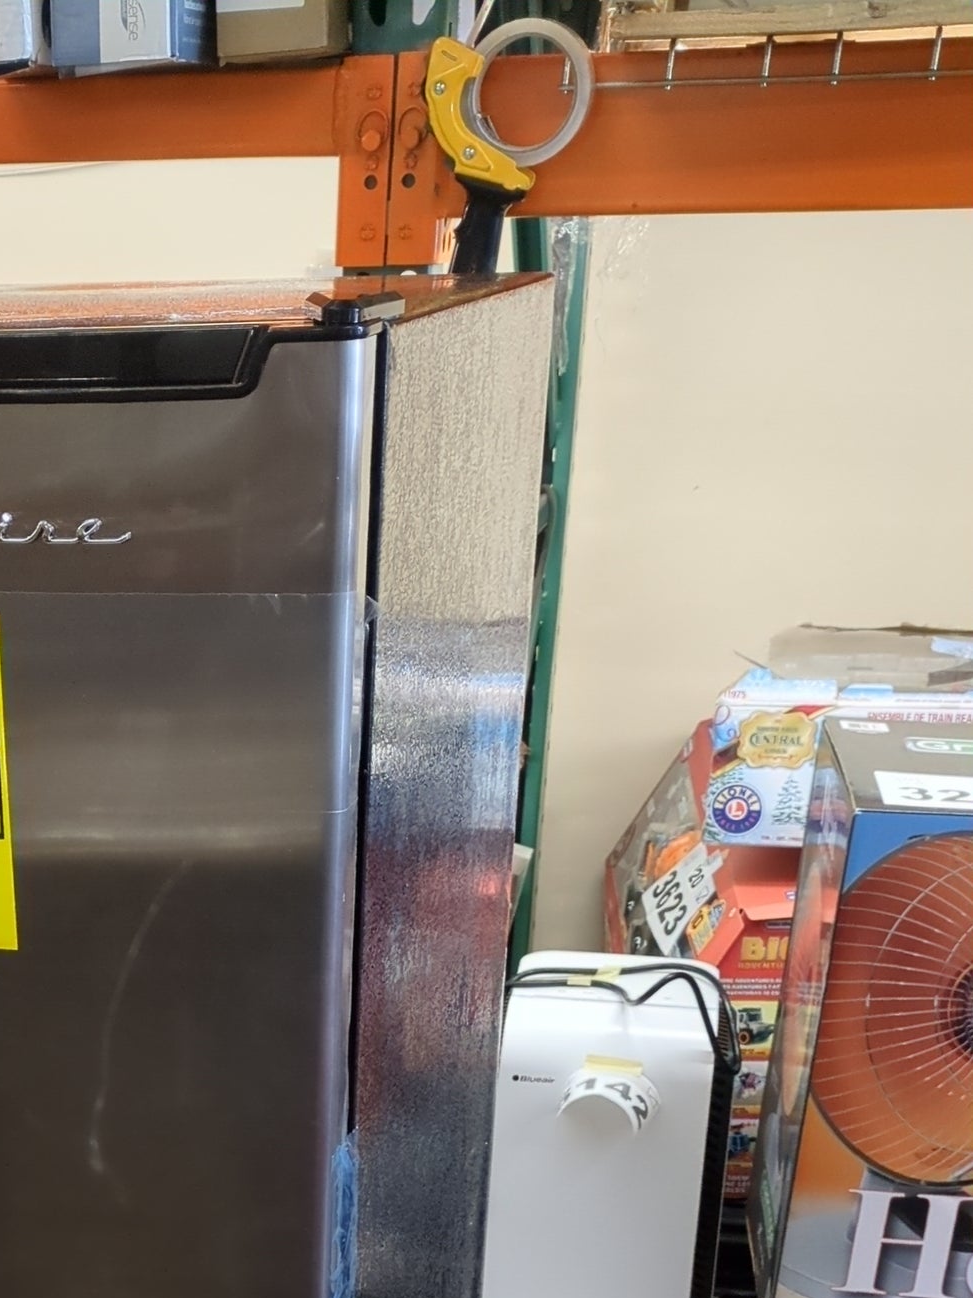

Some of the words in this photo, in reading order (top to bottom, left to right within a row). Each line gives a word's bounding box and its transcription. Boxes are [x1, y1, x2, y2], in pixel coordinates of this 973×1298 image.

[868, 711, 913, 721] ENSEMBLE
[913, 712, 925, 721] DE
[928, 713, 953, 723] TRAIN
[749, 732, 804, 747] CENTRAL
[715, 786, 759, 806] LIONEL
[653, 869, 688, 936] 3623
[519, 1075, 555, 1083] Blueair
